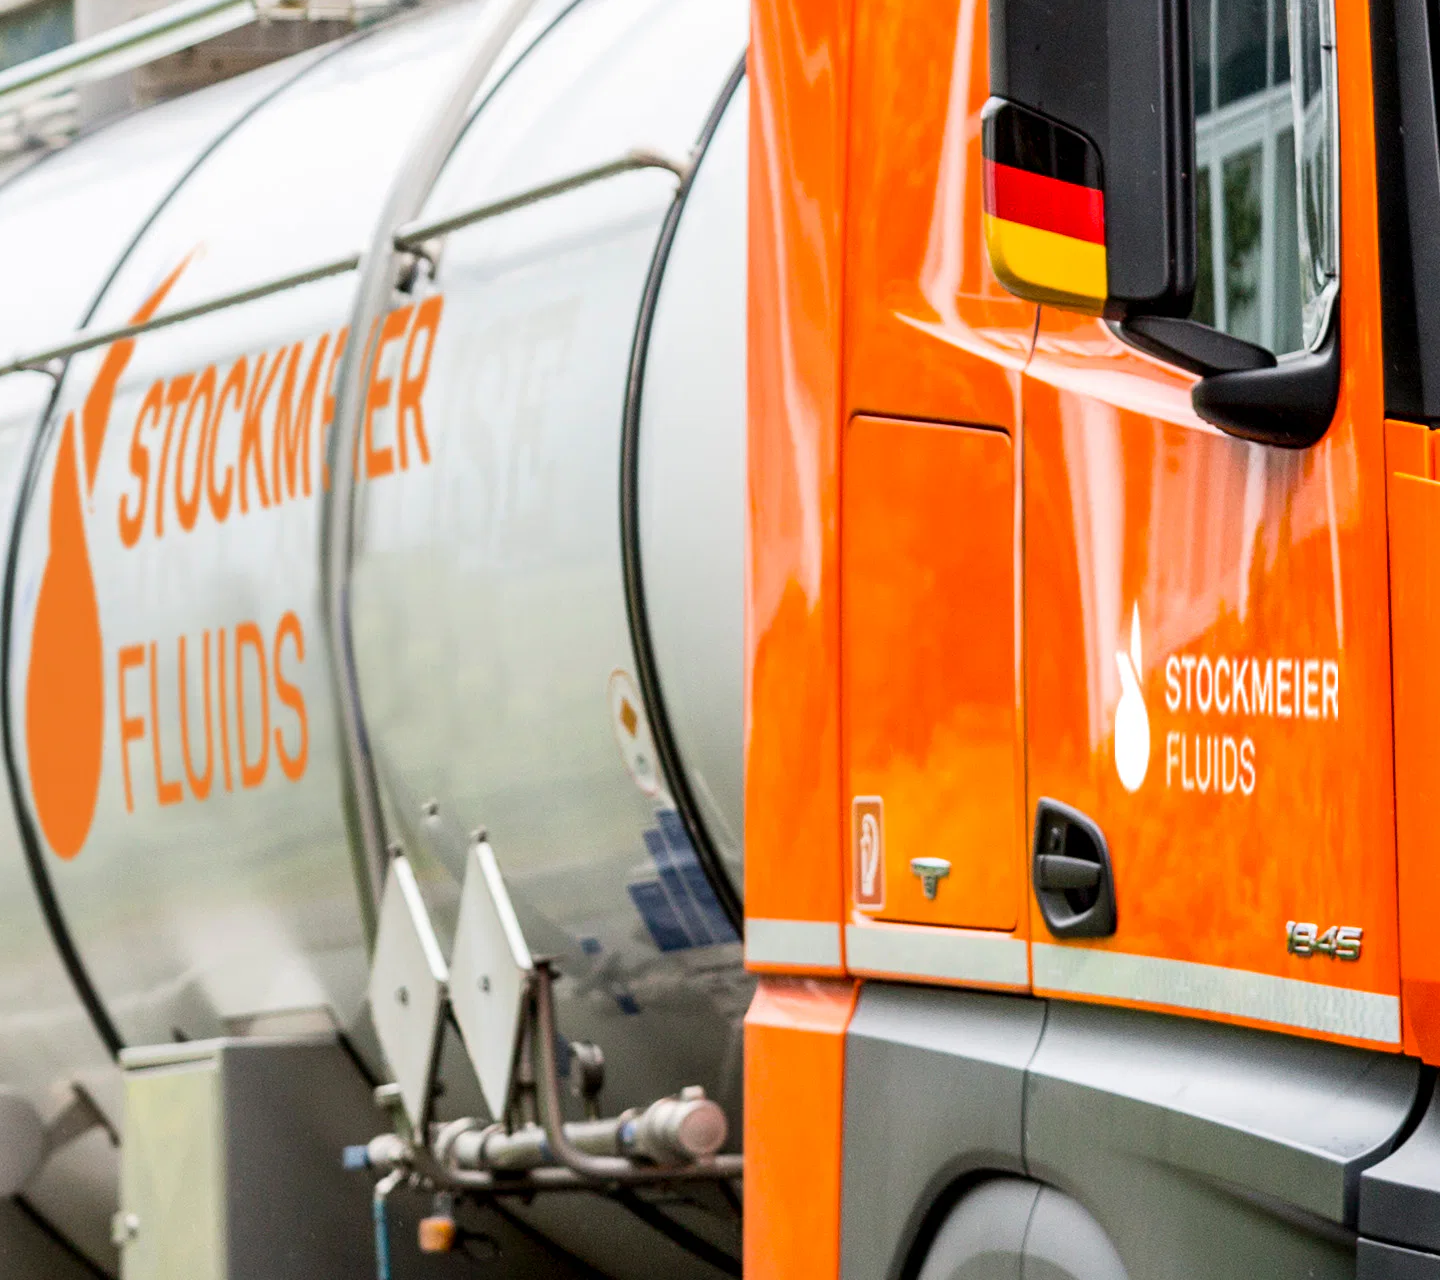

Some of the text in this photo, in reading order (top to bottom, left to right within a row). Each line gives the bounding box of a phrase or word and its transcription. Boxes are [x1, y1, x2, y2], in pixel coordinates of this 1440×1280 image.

[118, 611, 310, 814] FLUIDS
[1165, 655, 1340, 720] STOCKMEIER
[1166, 732, 1257, 795] FLUIDS
[1286, 920, 1363, 960] 1845
